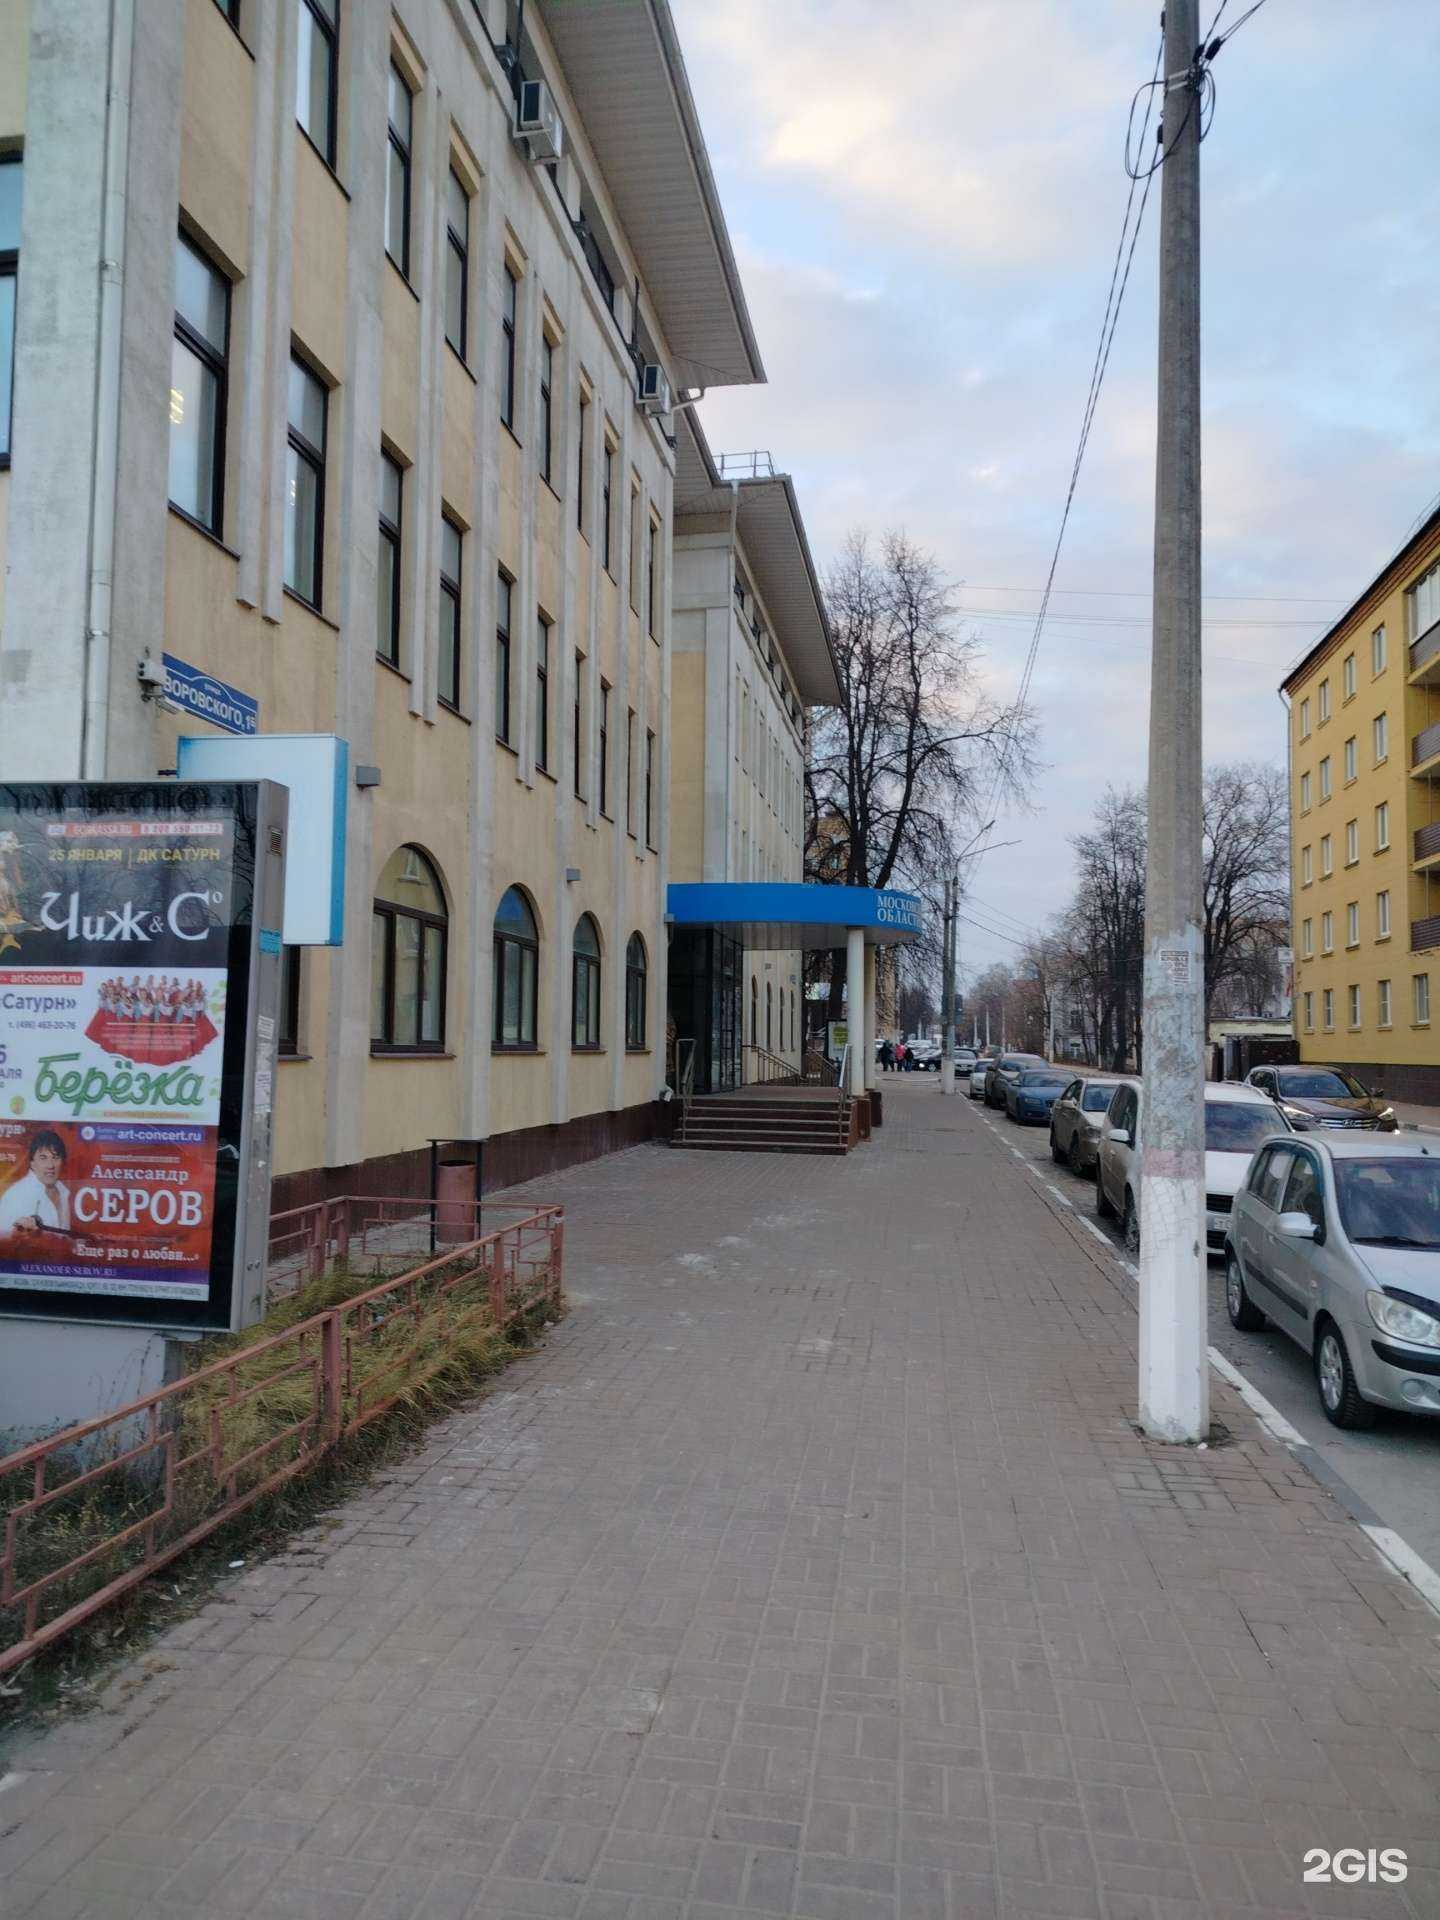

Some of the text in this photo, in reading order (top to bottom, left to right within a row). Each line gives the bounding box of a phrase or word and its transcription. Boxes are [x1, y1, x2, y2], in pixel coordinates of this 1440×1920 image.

[49, 849, 220, 864] 25 ЯНВАРЯ ДК САТУРН
[10, 973, 81, 984] art-concert.ru
[0, 993, 77, 1013] Сатурн»
[117, 1129, 202, 1141] art-concert.ru
[91, 1164, 189, 1185] Александр
[74, 1186, 203, 1226] СЕРОВ
[107, 1247, 128, 1260] раз
[131, 1249, 140, 1258] о
